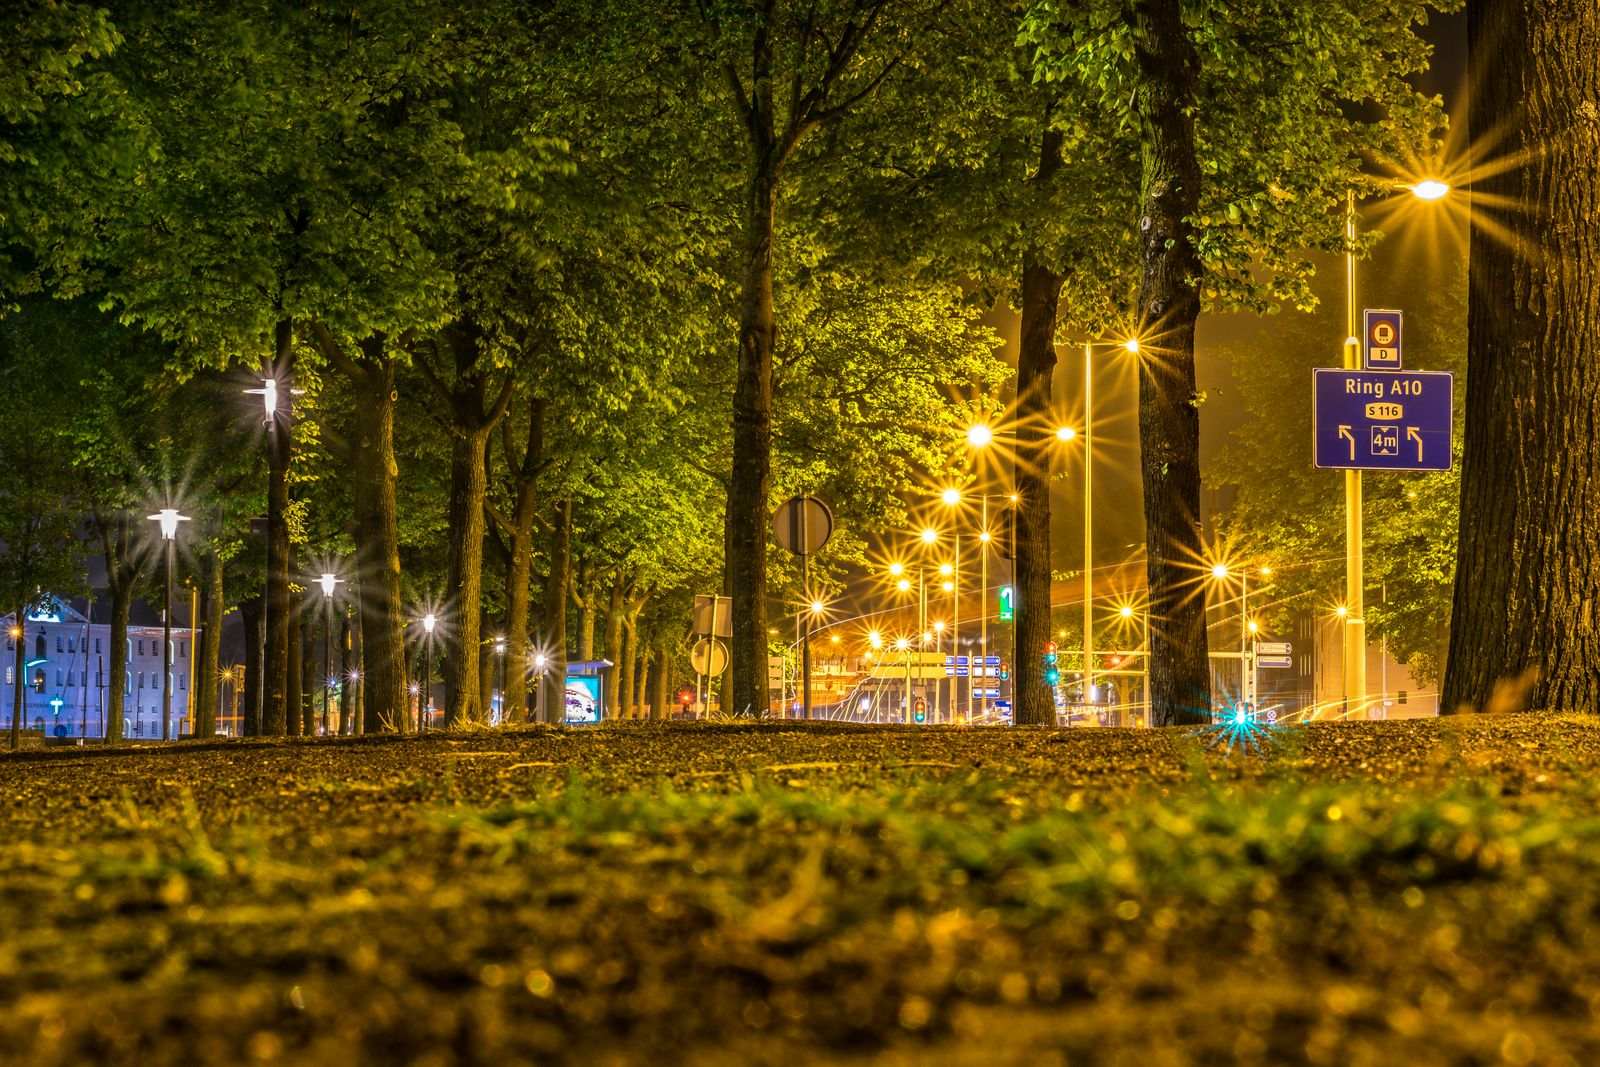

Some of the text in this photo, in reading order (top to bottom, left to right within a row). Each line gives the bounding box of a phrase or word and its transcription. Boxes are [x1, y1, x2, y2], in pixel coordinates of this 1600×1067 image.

[1379, 350, 1388, 360] D
[1345, 378, 1422, 398] Ring A10
[1373, 434, 1396, 447] 4m
